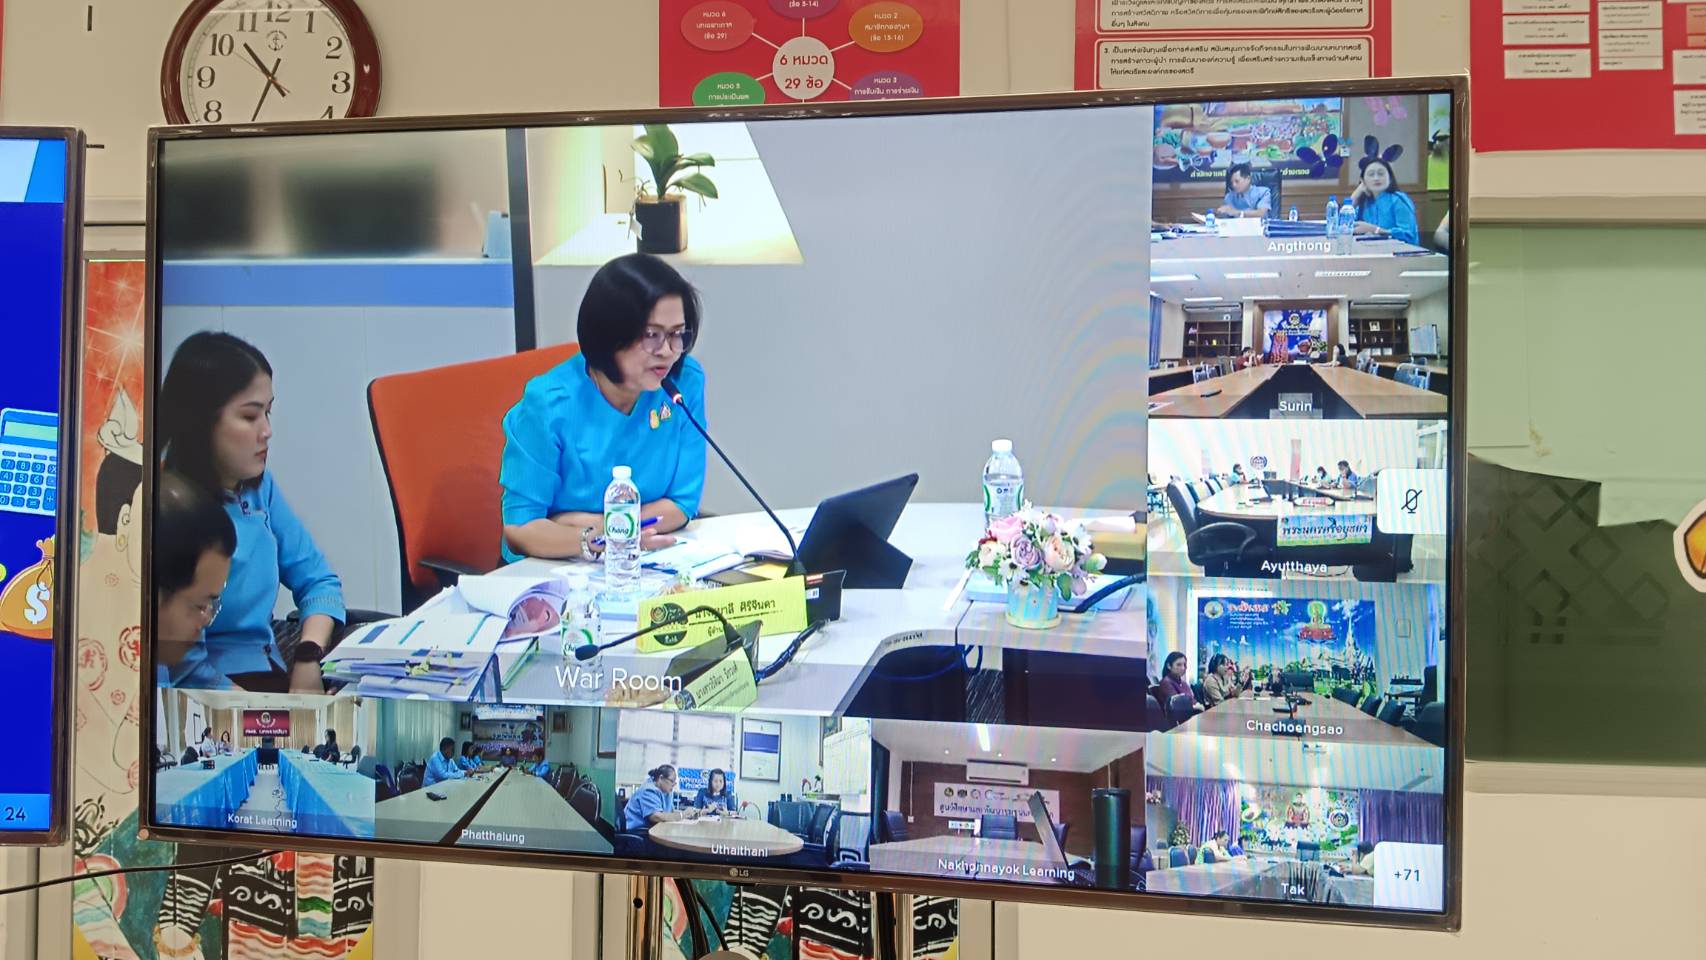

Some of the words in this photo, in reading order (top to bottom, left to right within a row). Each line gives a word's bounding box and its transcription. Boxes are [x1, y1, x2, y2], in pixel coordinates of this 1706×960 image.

[264, 0, 292, 23] 12
[236, 12, 258, 32] 11
[304, 11, 317, 33] 1
[209, 33, 234, 56] 10
[325, 36, 343, 59] 2
[779, 54, 788, 66] 6
[792, 54, 829, 66] หมวด
[197, 66, 216, 88] 9
[331, 71, 351, 94] 3
[784, 78, 801, 90] 29
[806, 75, 824, 90] ข้อ
[204, 100, 222, 123] 8
[1267, 240, 1332, 254] Angthong
[1278, 400, 1313, 413] Surin
[1261, 559, 1328, 574] Ayutthaya
[555, 666, 602, 689] War
[611, 667, 682, 692] Room
[1246, 720, 1343, 736] Chachoengsao
[4, 806, 26, 822] 24
[227, 813, 253, 826] Korat
[254, 815, 298, 829] Learning
[461, 829, 525, 845] Phatthalung
[711, 843, 768, 858] Uthaithani
[1022, 864, 1076, 882] Learning
[1393, 867, 1421, 882] +71
[1281, 882, 1305, 896] Tak
